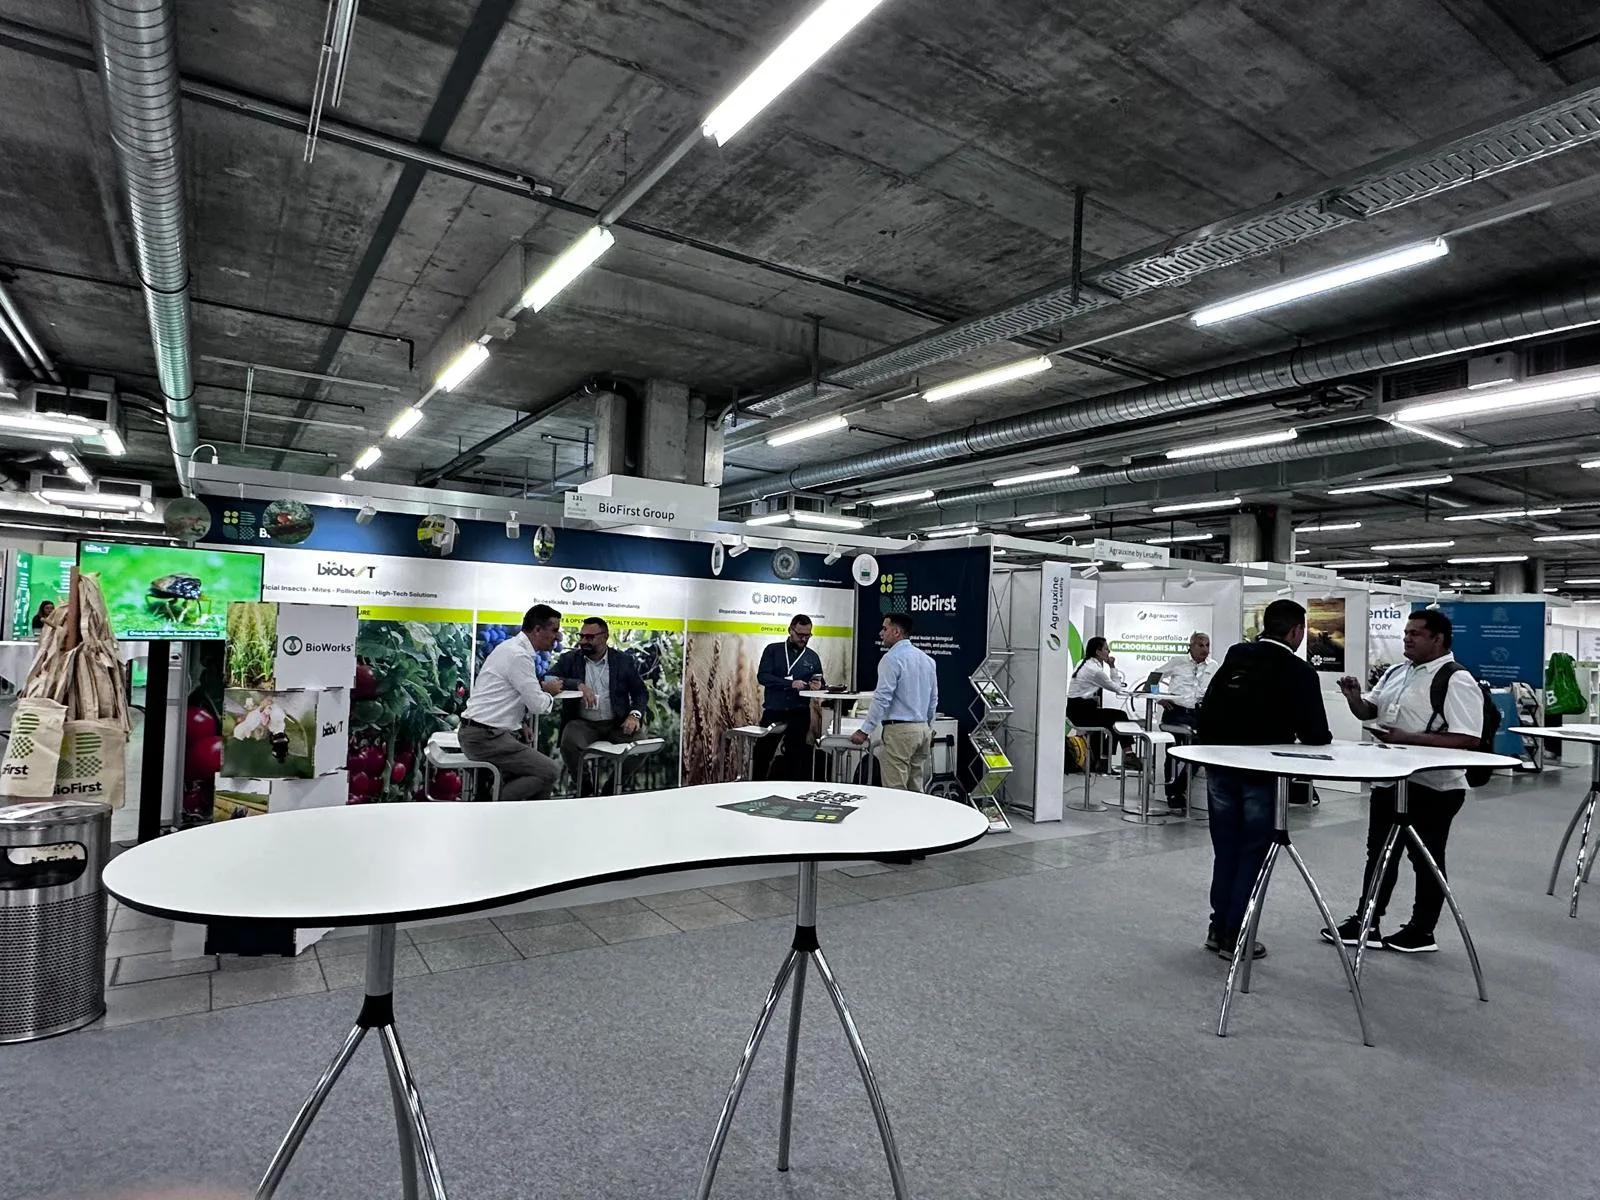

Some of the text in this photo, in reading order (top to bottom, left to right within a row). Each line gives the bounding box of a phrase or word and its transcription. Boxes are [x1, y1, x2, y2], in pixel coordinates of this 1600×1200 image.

[598, 502, 641, 517] BioFirst
[643, 507, 675, 522] Group
[1109, 547, 1135, 556] Agrauxine
[1135, 549, 1143, 559] by
[1143, 551, 1163, 560] Lesaffre
[336, 587, 371, 595] Pollination
[375, 589, 408, 597] High-Tech
[579, 583, 618, 592] BioWorks
[763, 595, 797, 604] BIOTROP
[911, 595, 957, 611] BioFirst
[1050, 576, 1060, 630] Agrauxine
[1121, 633, 1152, 641] Complete
[1153, 634, 1183, 642] portfolio
[305, 643, 351, 652] BioWorks
[1111, 643, 1176, 652] MICROORGANISM
